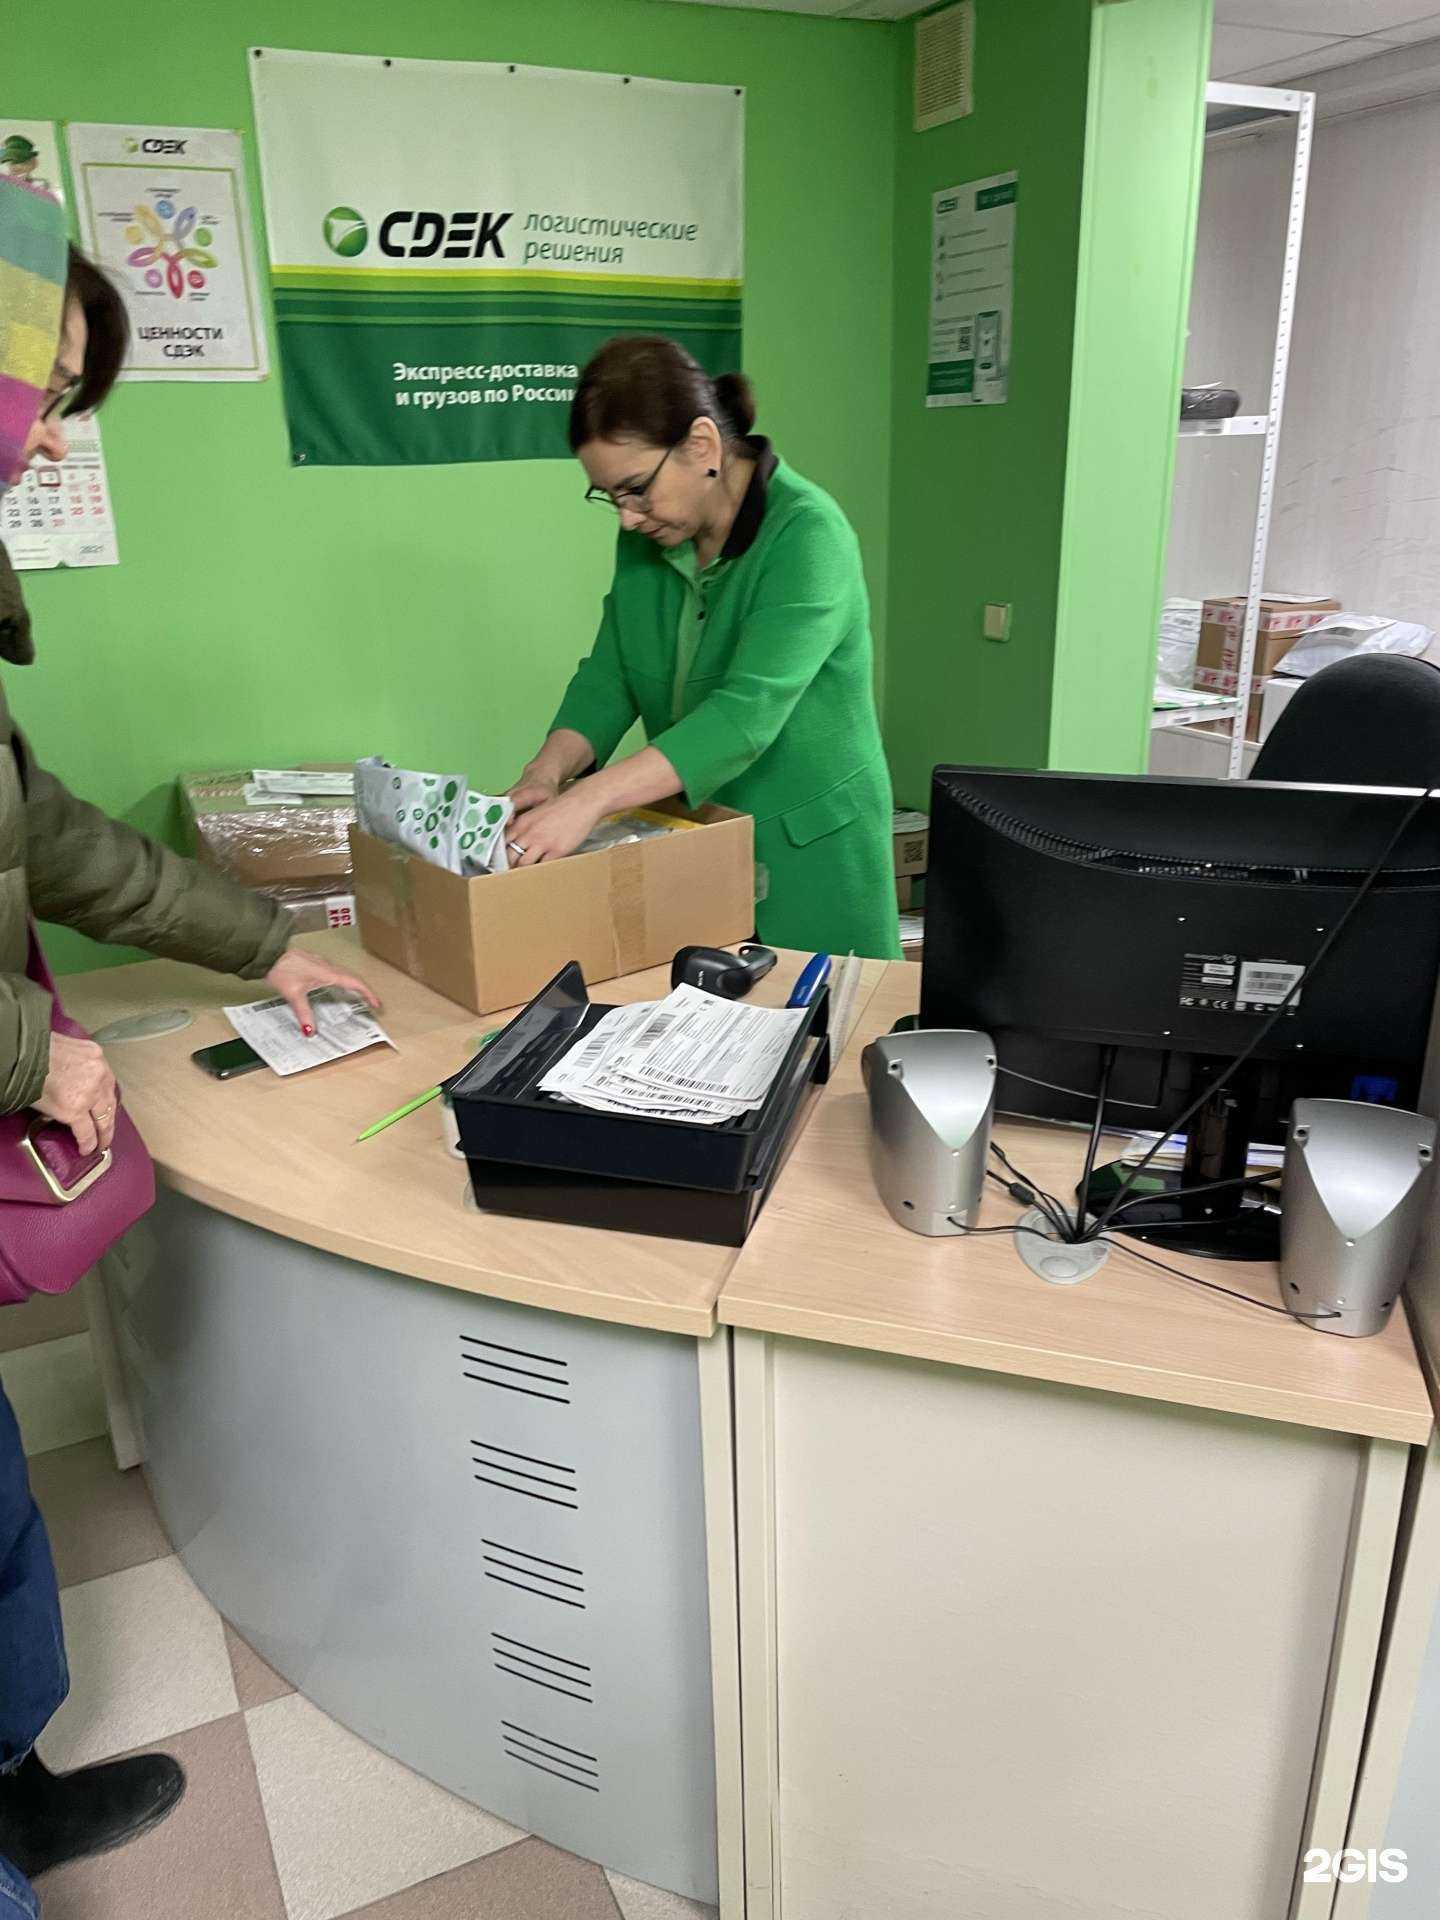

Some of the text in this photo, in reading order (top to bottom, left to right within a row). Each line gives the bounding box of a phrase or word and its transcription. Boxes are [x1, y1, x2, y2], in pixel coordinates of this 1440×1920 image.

[523, 212, 698, 242] логистические
[522, 239, 625, 265] решения
[138, 326, 224, 342] ЦЕННОСТИ
[162, 344, 205, 359] СДЭК
[392, 362, 579, 385] Экспресс-доставка
[395, 391, 410, 406] и
[413, 389, 482, 409] грузов
[484, 388, 508, 403] по
